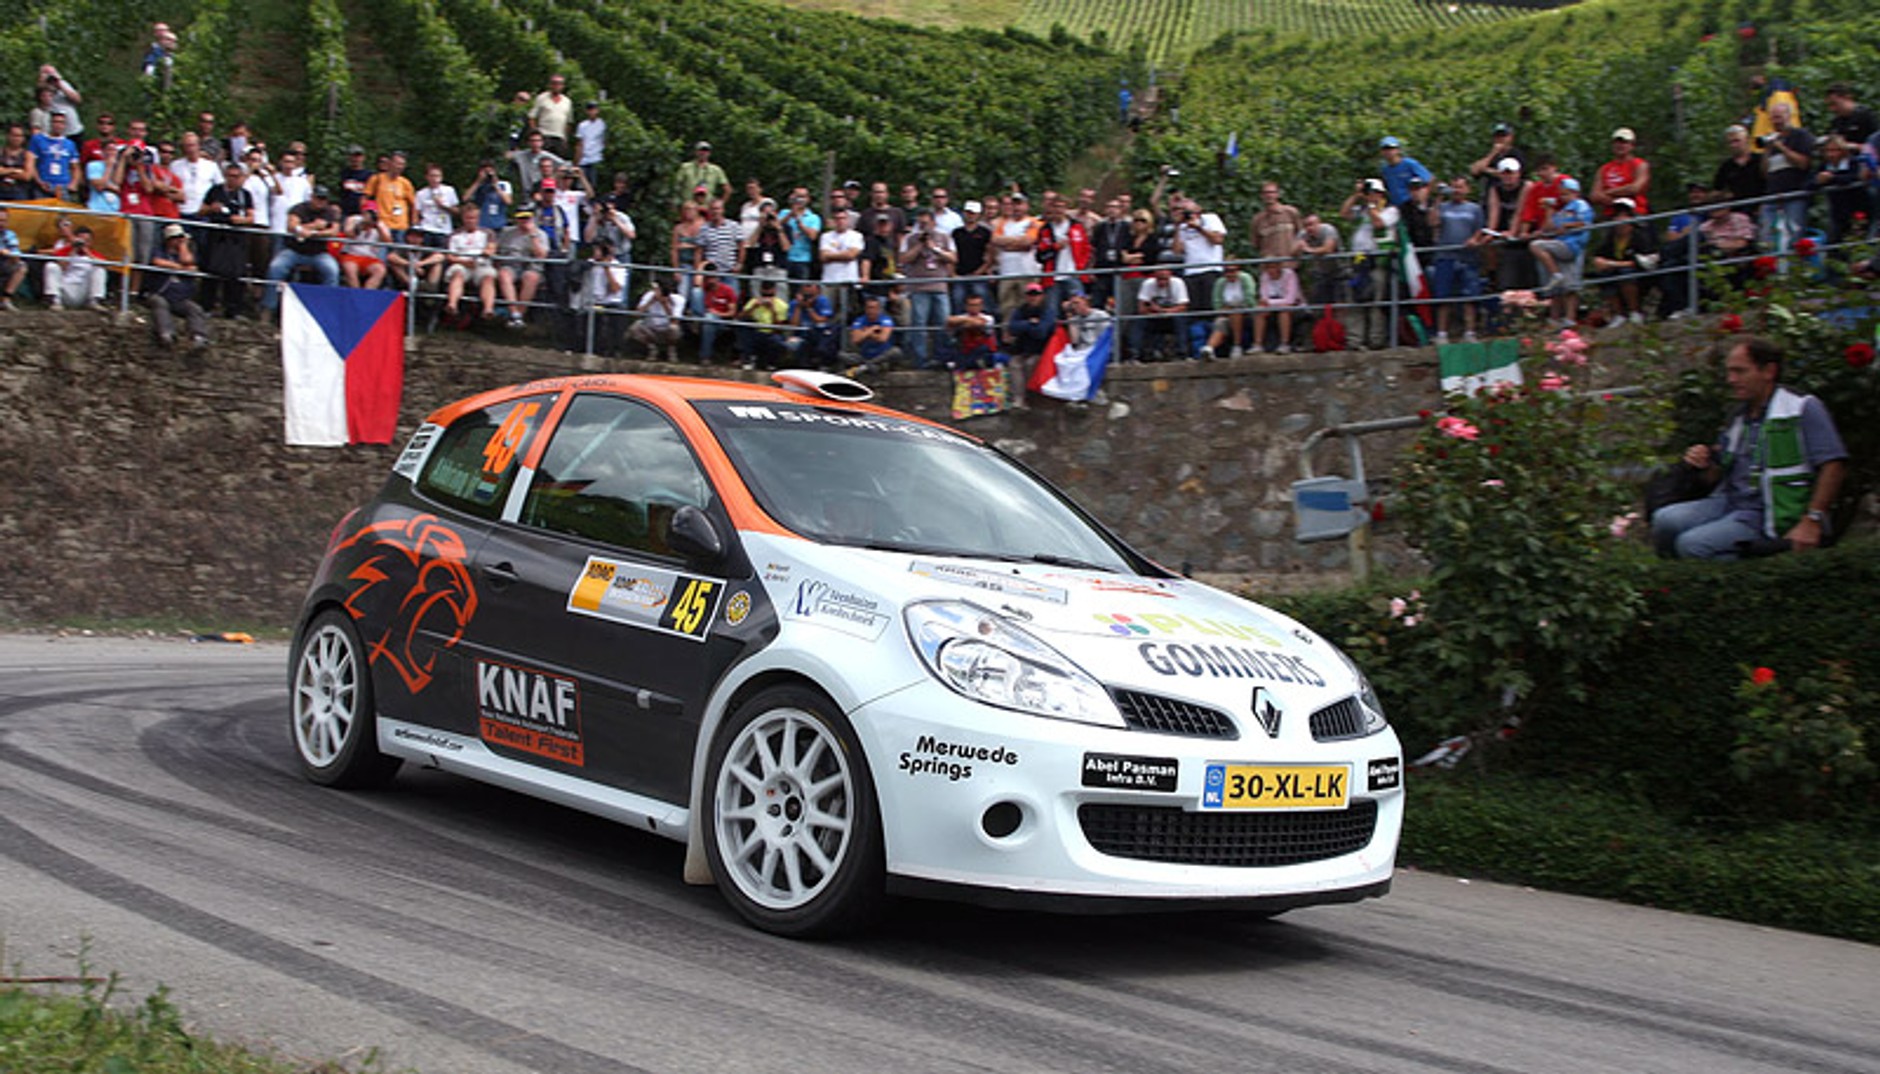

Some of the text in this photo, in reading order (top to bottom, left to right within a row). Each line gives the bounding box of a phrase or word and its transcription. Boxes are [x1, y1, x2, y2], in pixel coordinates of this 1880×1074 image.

[482, 402, 541, 474] 45
[670, 580, 714, 634] 45
[1136, 613, 1283, 648] PLUS
[1138, 642, 1327, 688] GOMMERS
[478, 661, 576, 727] KNAF
[486, 721, 533, 747] Talent
[538, 736, 578, 761] First
[916, 735, 1019, 766] Merwede
[899, 752, 973, 782] Springs
[1085, 758, 1176, 777] Abel Pasman
[1106, 772, 1158, 786] Infra B.V.
[1206, 791, 1222, 804] NL
[1228, 773, 1344, 800] 30-XL-LK
